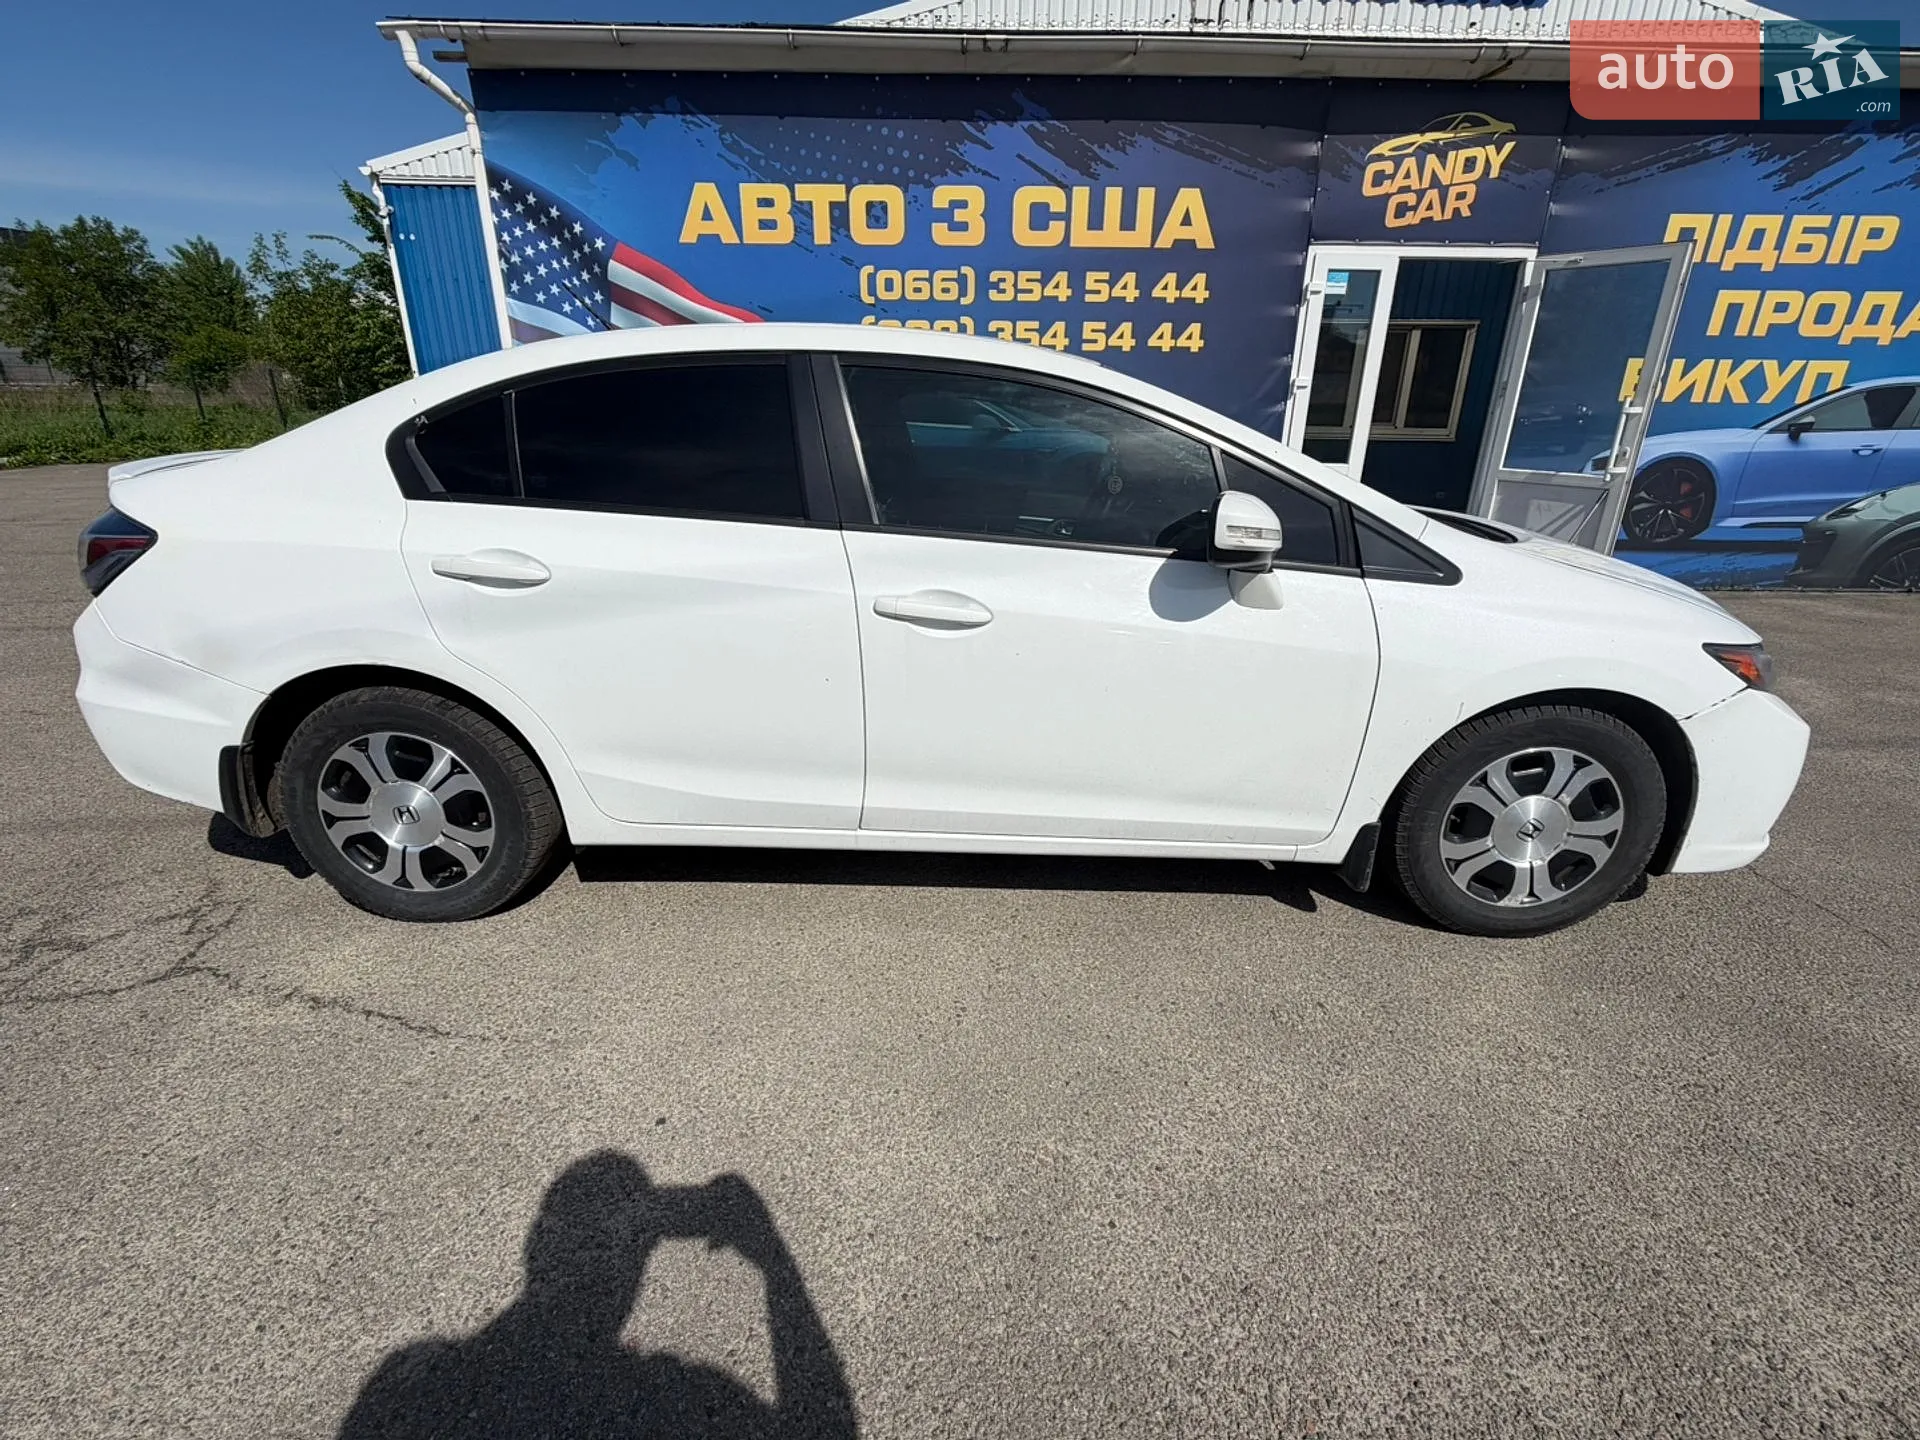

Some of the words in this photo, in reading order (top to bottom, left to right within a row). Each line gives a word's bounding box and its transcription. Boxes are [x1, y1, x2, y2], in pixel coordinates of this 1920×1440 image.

[1362, 141, 1517, 197] CANDY
[679, 182, 905, 246] АВТО
[931, 185, 986, 247] З
[1012, 185, 1216, 249] США
[1385, 183, 1477, 228] CAR
[1663, 213, 1901, 272] ПІДБІР
[859, 265, 976, 305] (066)
[988, 270, 1072, 302] 354
[1084, 271, 1140, 303] 54
[1151, 272, 1210, 304] 44
[1082, 321, 1136, 352] 54
[1147, 322, 1205, 353] 44
